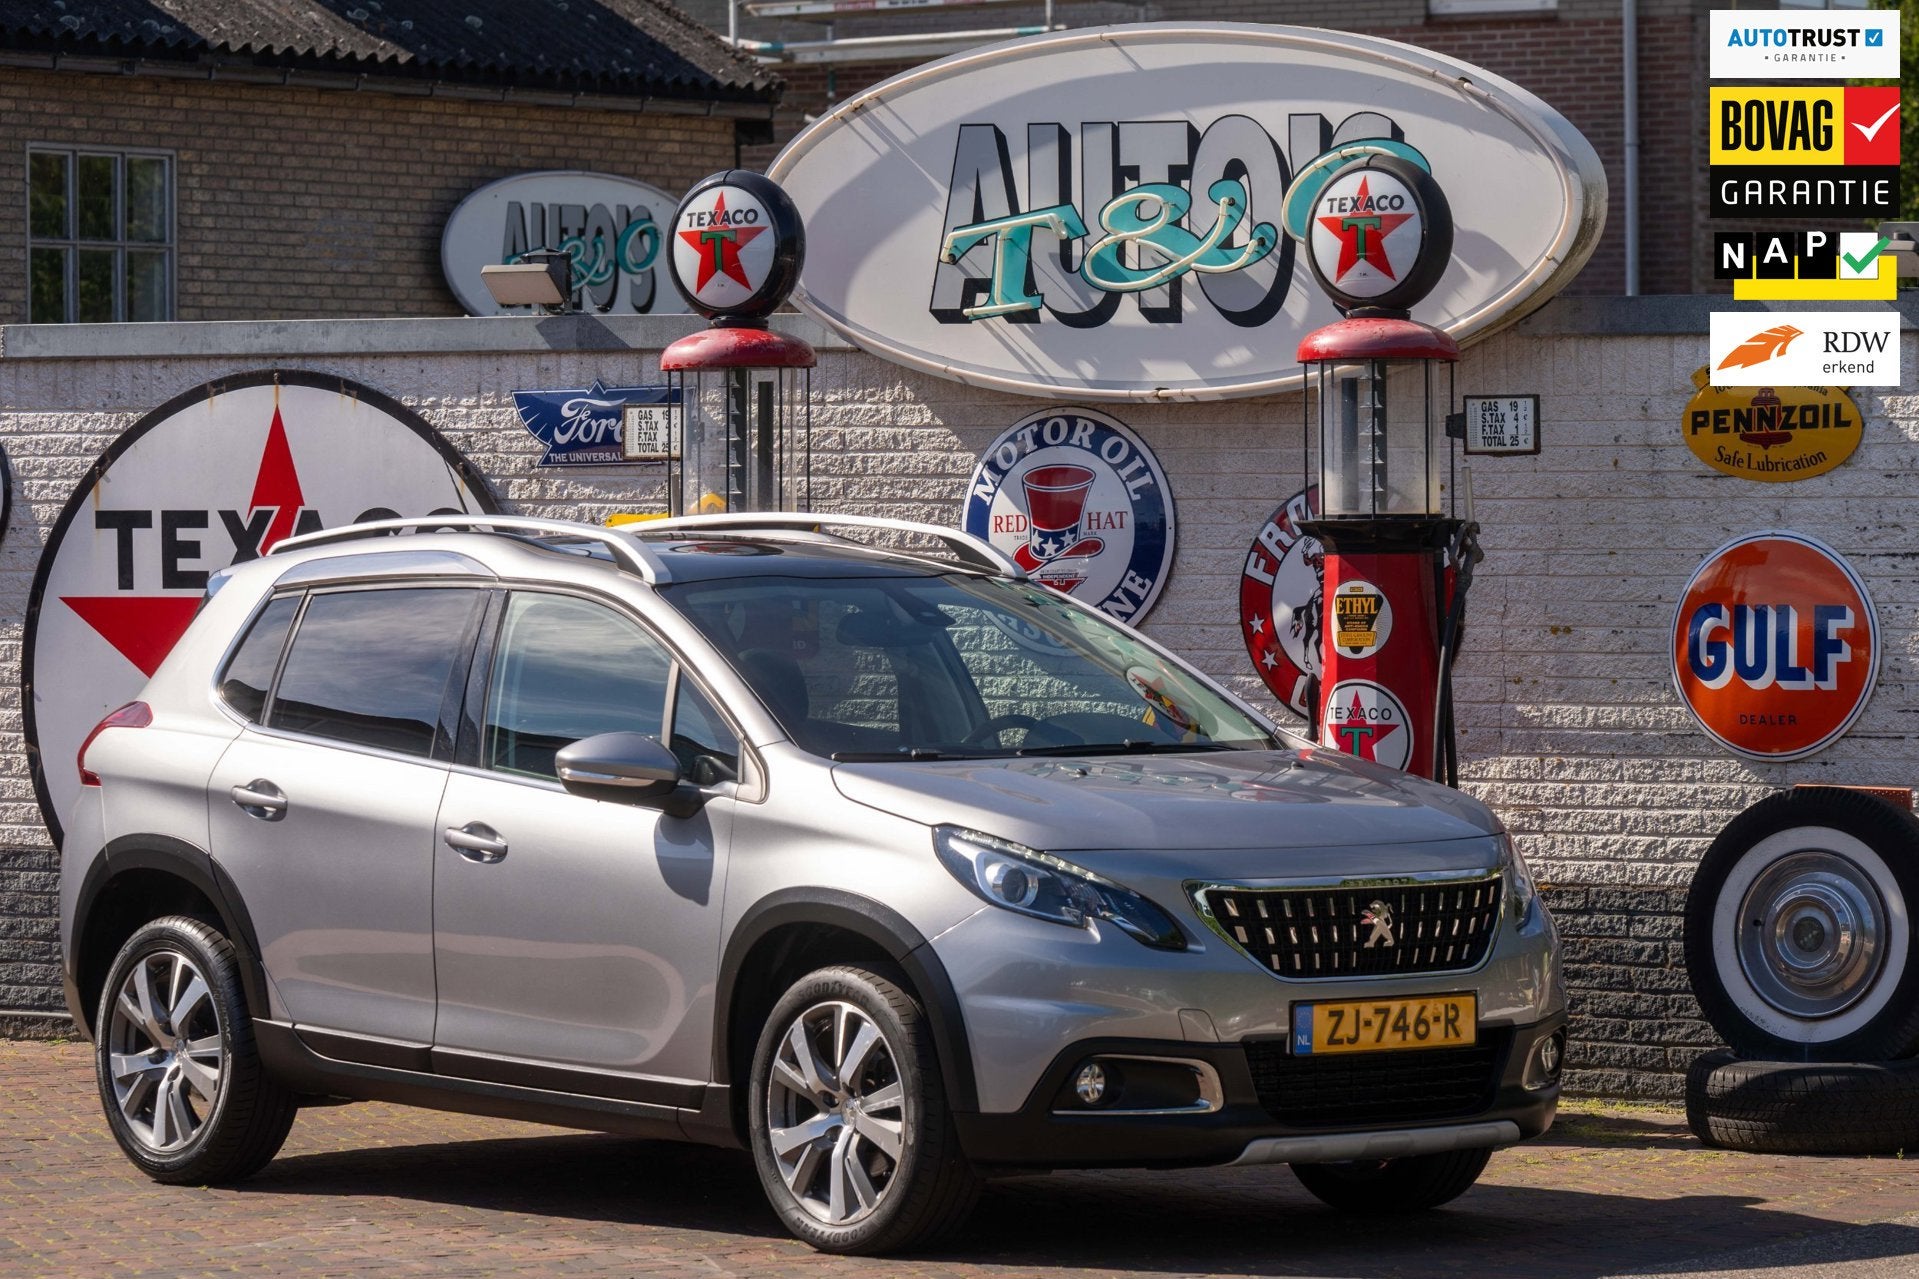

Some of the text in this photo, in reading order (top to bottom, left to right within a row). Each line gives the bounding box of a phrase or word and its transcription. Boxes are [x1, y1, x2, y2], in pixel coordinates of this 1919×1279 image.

[1327, 193, 1405, 213] TEXACO
[687, 207, 758, 227] TEXACO
[1481, 401, 1518, 412] GAS 19
[638, 410, 653, 420] GAS
[1481, 413, 1506, 423] S.TAX
[1513, 413, 1519, 423] 4
[1691, 403, 1852, 435] PENNZOIL
[638, 421, 657, 431] S.TAX
[1481, 424, 1519, 435] F.TAX 1
[638, 432, 657, 441] F.TAX
[1482, 435, 1507, 447] TOTAL
[1510, 435, 1519, 446] 25
[638, 443, 659, 453] TOTAL
[549, 451, 623, 463] THE UNIVERSAL
[973, 417, 1154, 506] MOTOR OIL
[1714, 445, 1827, 472] Safe Lubrication
[993, 510, 1128, 534] RED HAT
[1097, 569, 1152, 621] NE
[1336, 597, 1378, 614] ETHYL
[1688, 602, 1855, 690] GULF
[1330, 707, 1392, 721] TEXACO
[1739, 714, 1797, 725] DEALER
[1327, 1003, 1461, 1045] ZJ-746-R
[1297, 1035, 1310, 1046] NL
